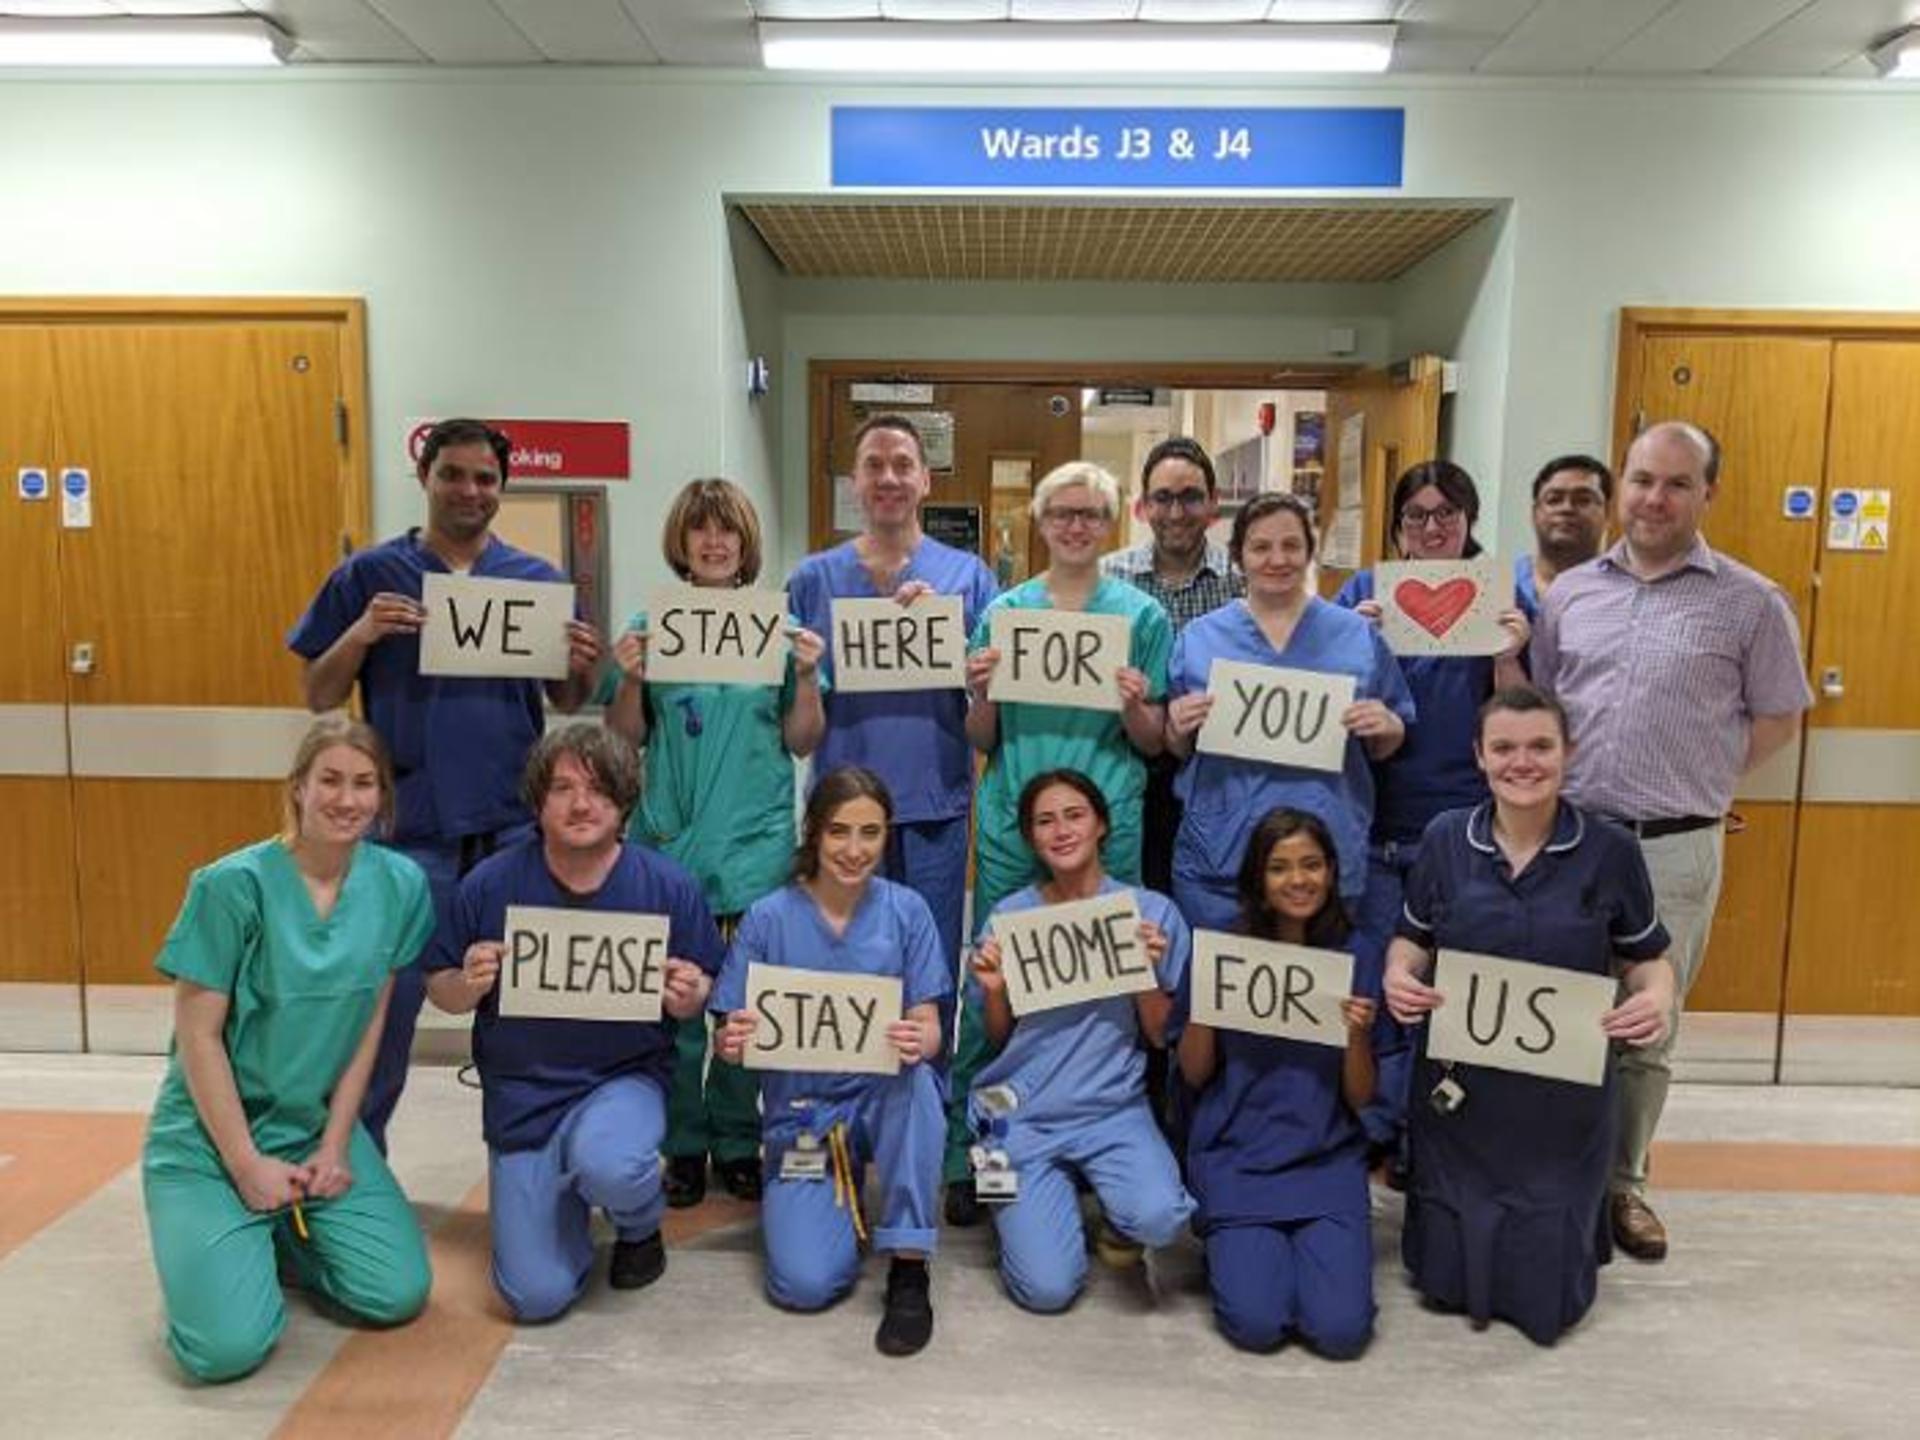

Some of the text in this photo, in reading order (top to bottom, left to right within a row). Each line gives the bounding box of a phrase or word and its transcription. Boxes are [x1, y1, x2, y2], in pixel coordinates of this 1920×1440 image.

[981, 126, 1251, 159] Wards J3 & J4
[509, 447, 563, 470] oking
[448, 597, 535, 656] WE
[659, 608, 780, 659] STAY
[841, 614, 952, 670] HERE
[1011, 626, 1102, 686] FOR
[1232, 679, 1330, 744] YOU
[511, 930, 663, 995] PLEASE
[1011, 912, 1147, 994] HOME
[1214, 954, 1320, 1025] FOR
[1466, 973, 1558, 1054] US
[756, 989, 878, 1053] STAY
